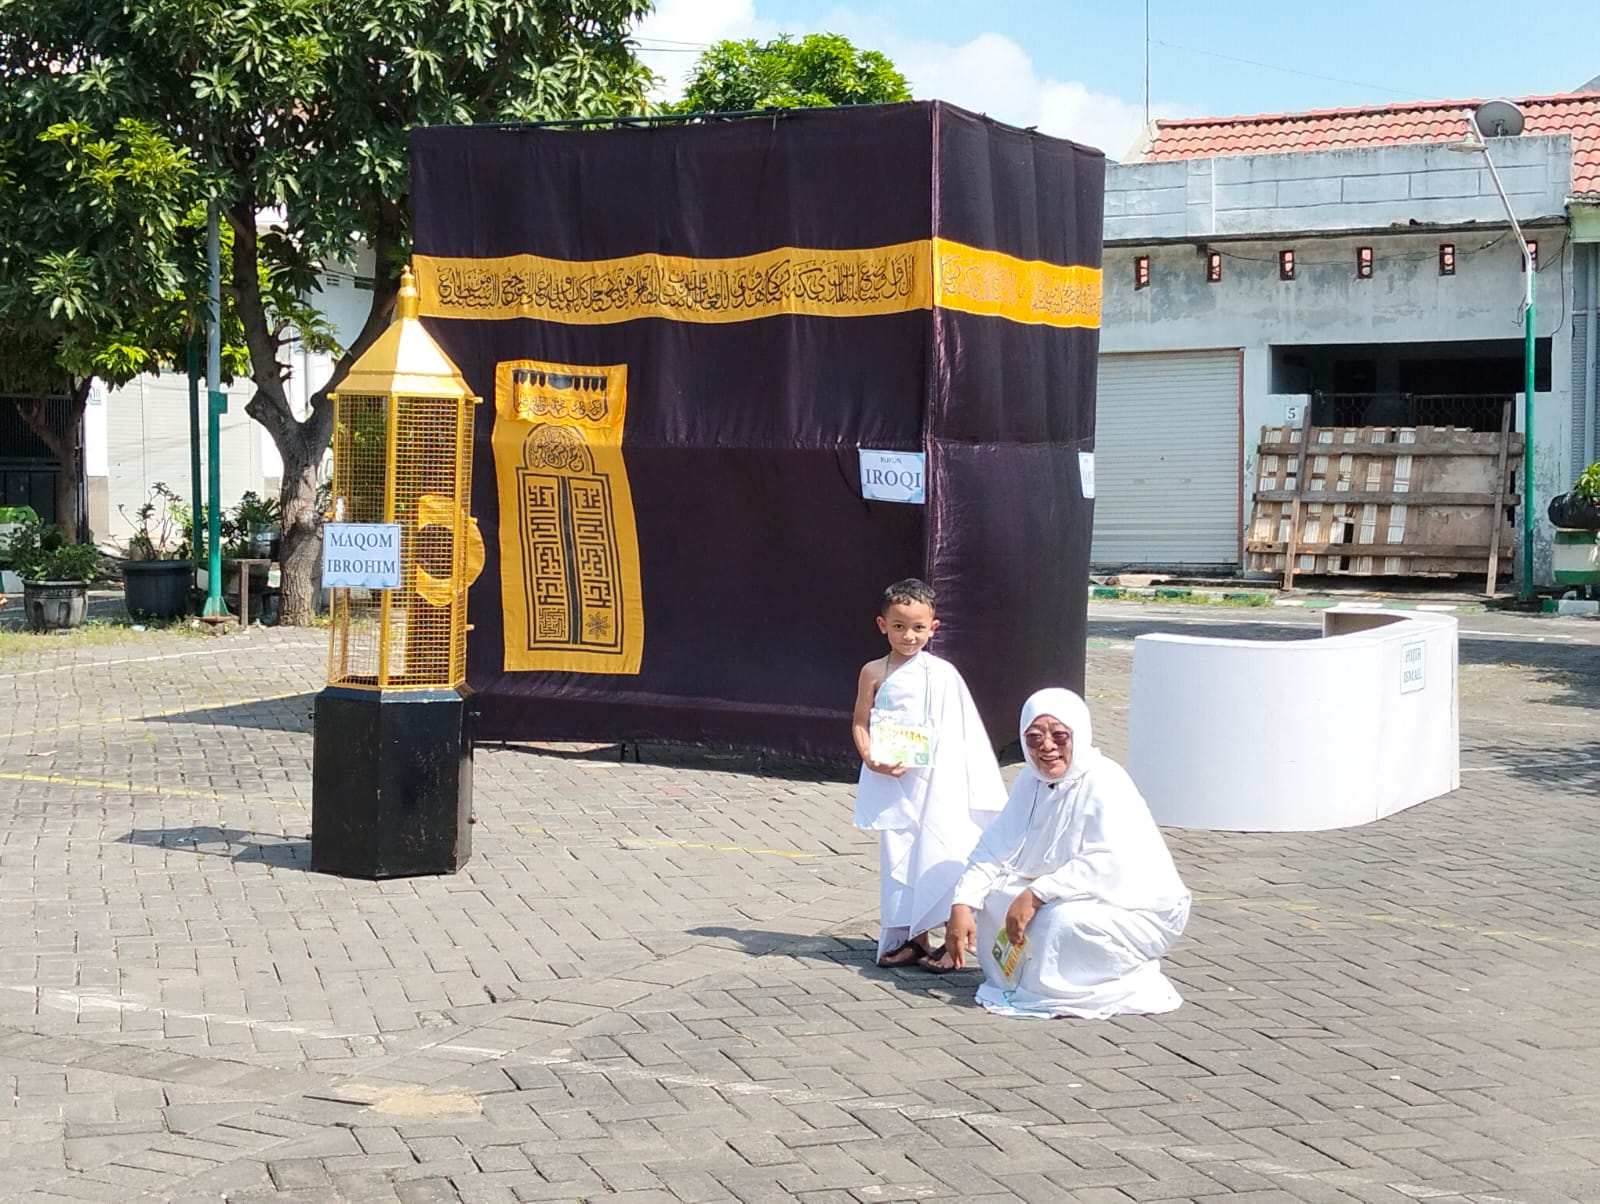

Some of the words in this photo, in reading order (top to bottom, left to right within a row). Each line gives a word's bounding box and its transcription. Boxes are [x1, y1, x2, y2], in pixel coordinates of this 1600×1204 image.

[1288, 407, 1297, 420] 5
[865, 468, 921, 491] IROQI
[330, 532, 393, 551] MAQOM
[327, 559, 396, 575] IBROHIM
